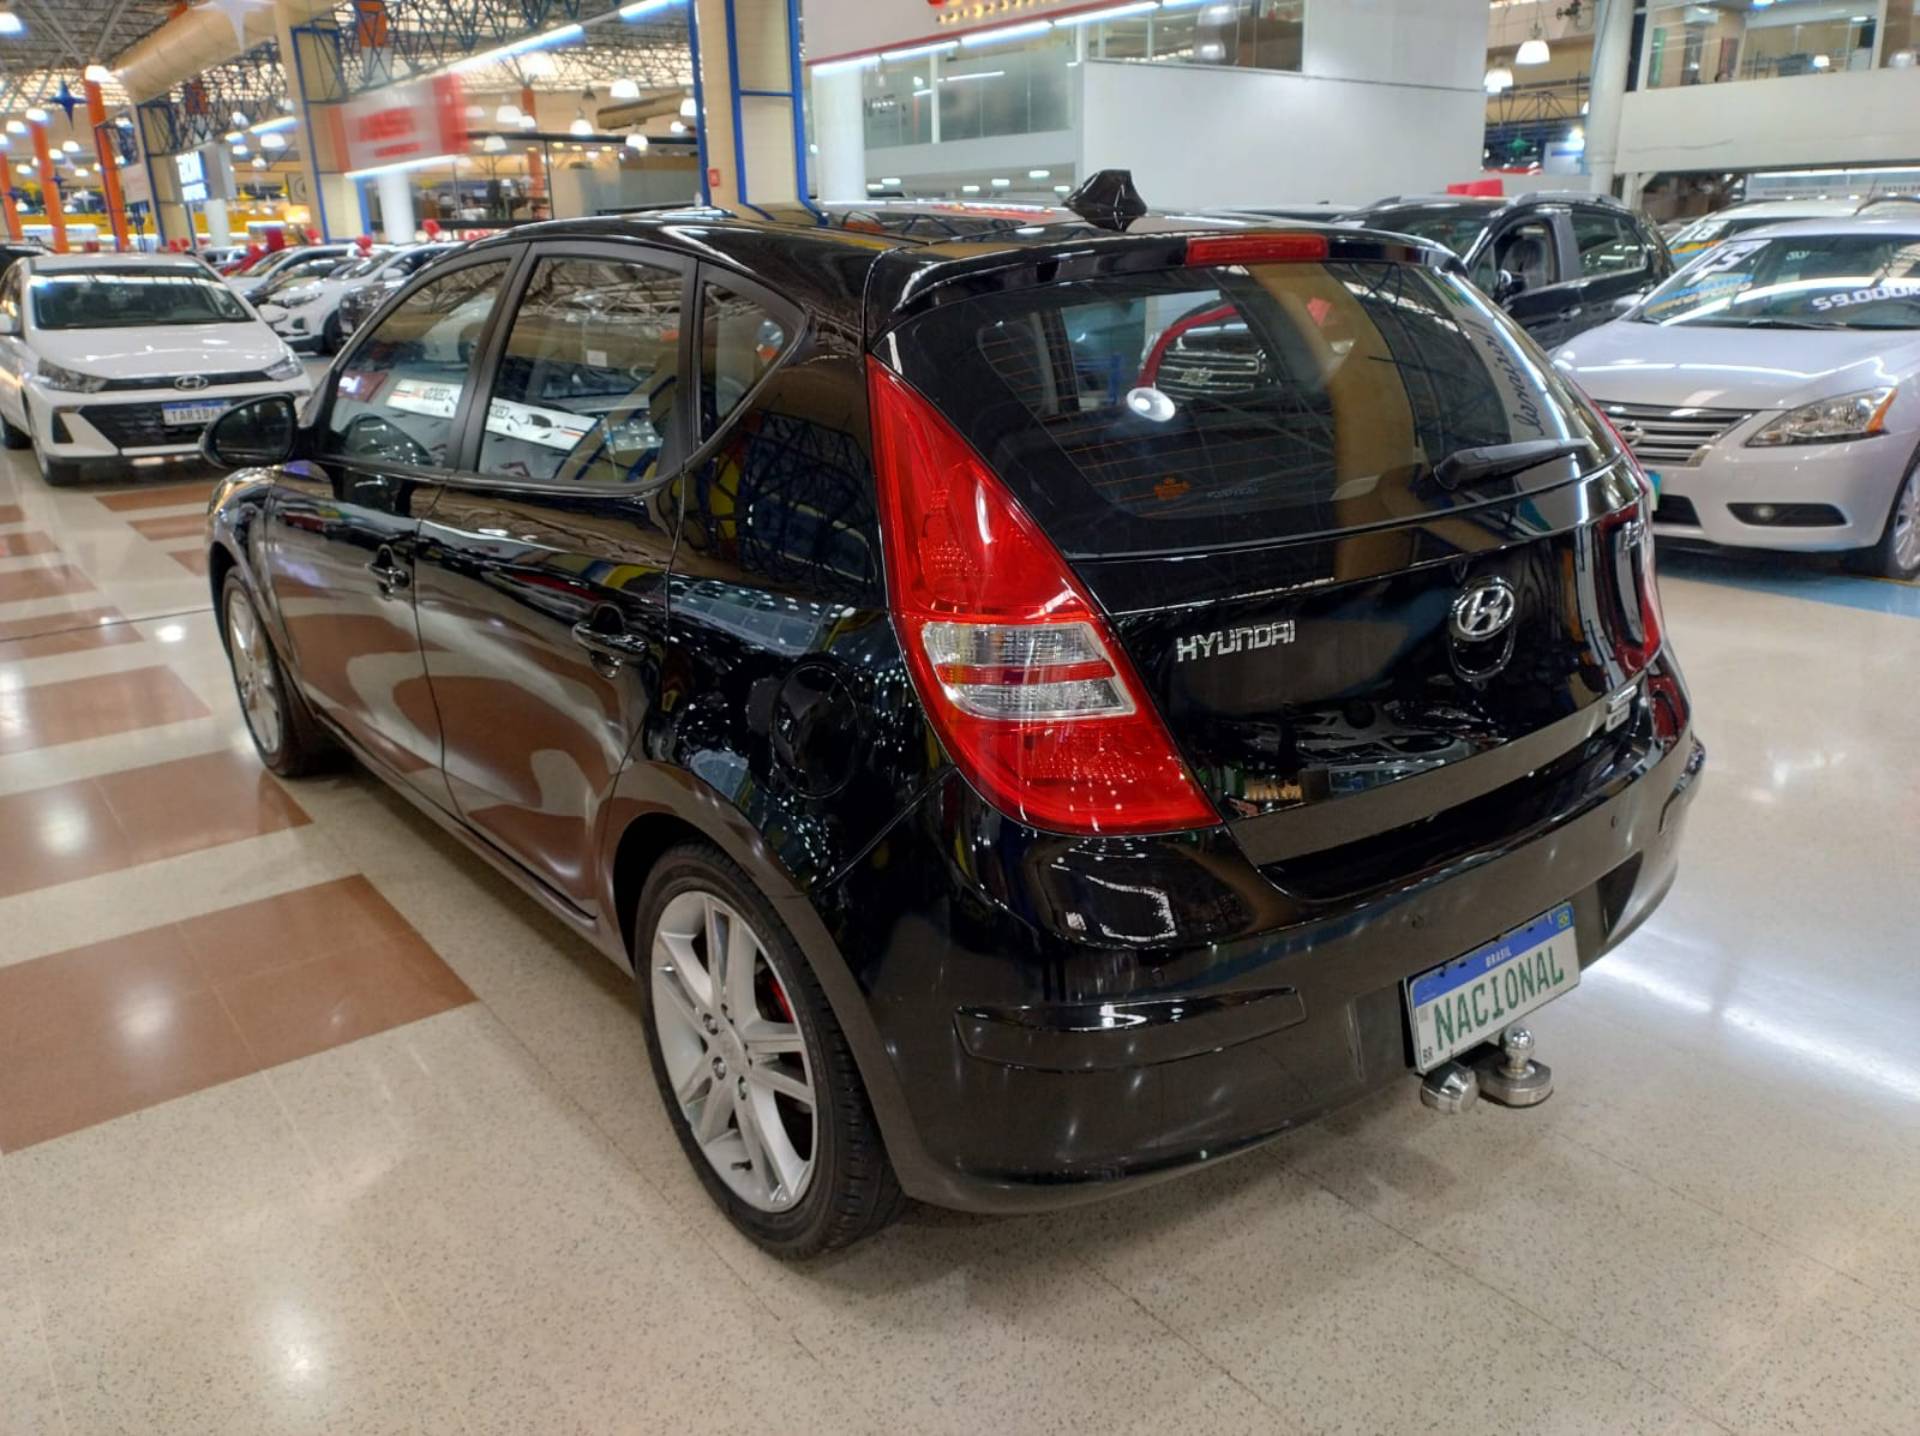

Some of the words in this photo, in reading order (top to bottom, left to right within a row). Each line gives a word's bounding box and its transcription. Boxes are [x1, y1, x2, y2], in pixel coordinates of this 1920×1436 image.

[1176, 619, 1296, 662] HYUNDAI
[1486, 947, 1512, 968] BRASIL
[1433, 946, 1565, 1051] NACIONAL
